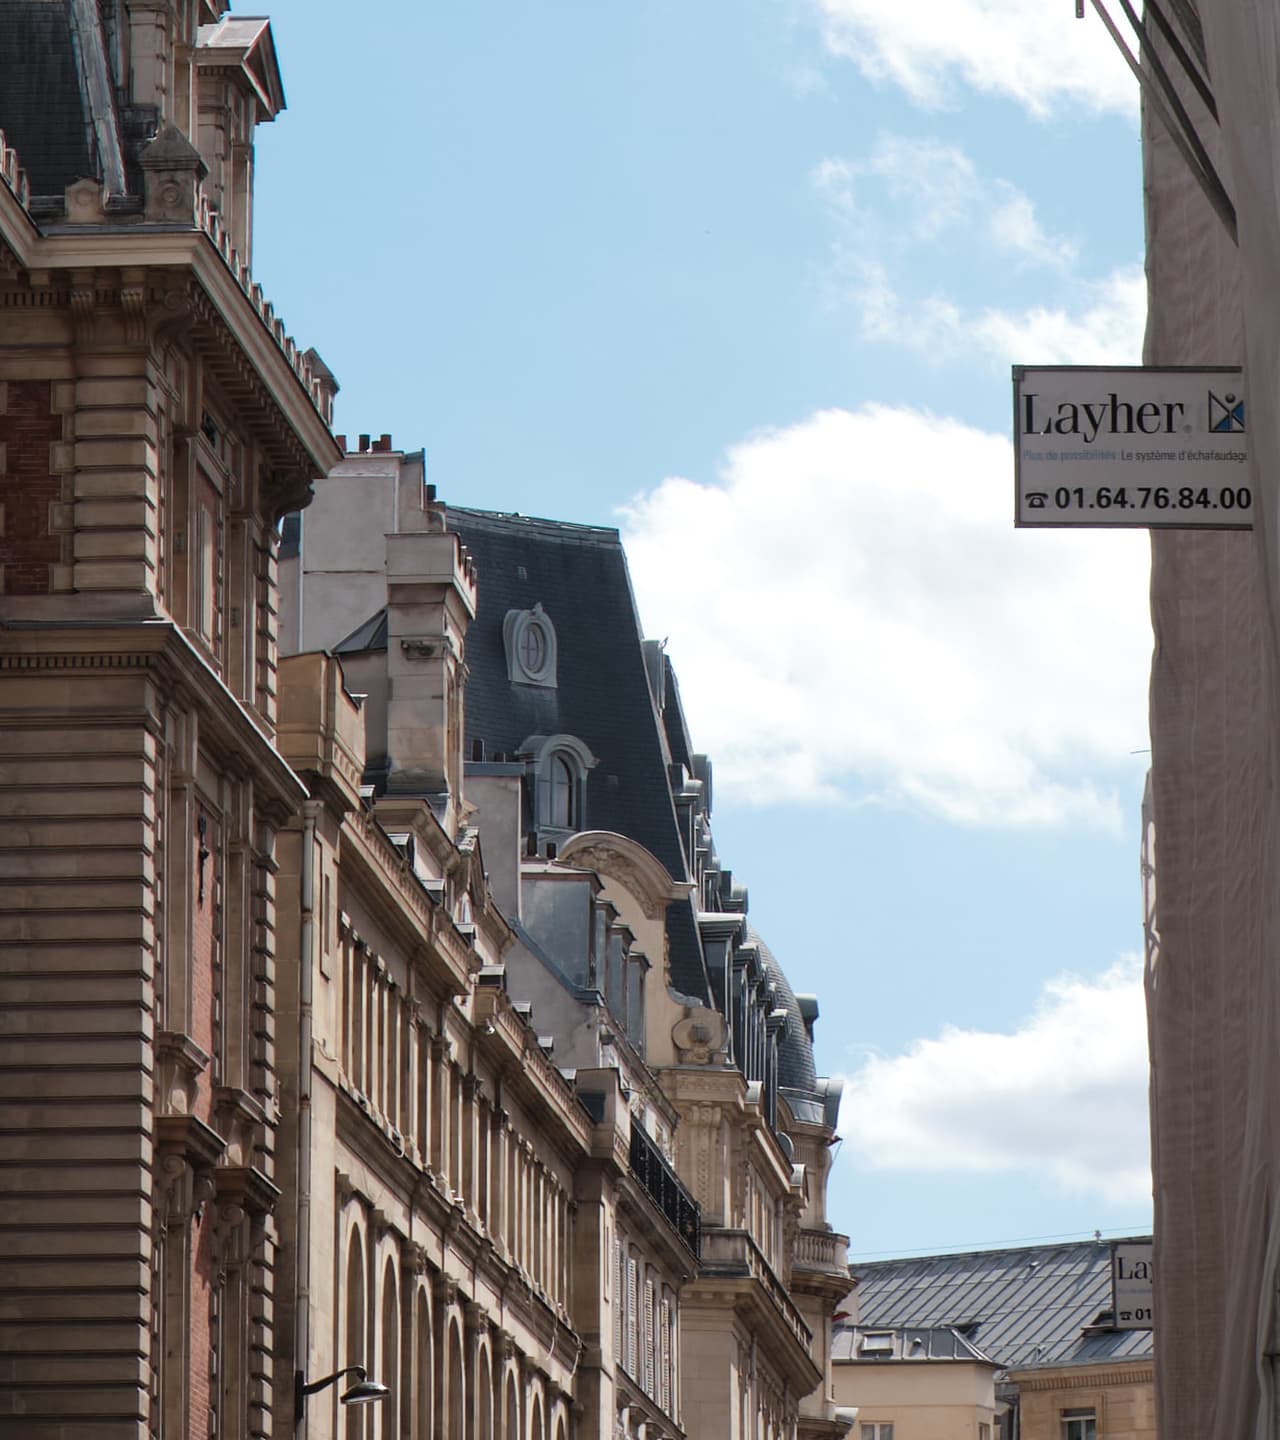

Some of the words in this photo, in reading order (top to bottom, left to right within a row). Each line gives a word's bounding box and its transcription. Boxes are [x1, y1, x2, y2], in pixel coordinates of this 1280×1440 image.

[1023, 392, 1185, 443] Layher
[1121, 451, 1133, 462] Le
[1055, 486, 1251, 509] 01.64.76.84.00
[1136, 1308, 1152, 1321] 01
